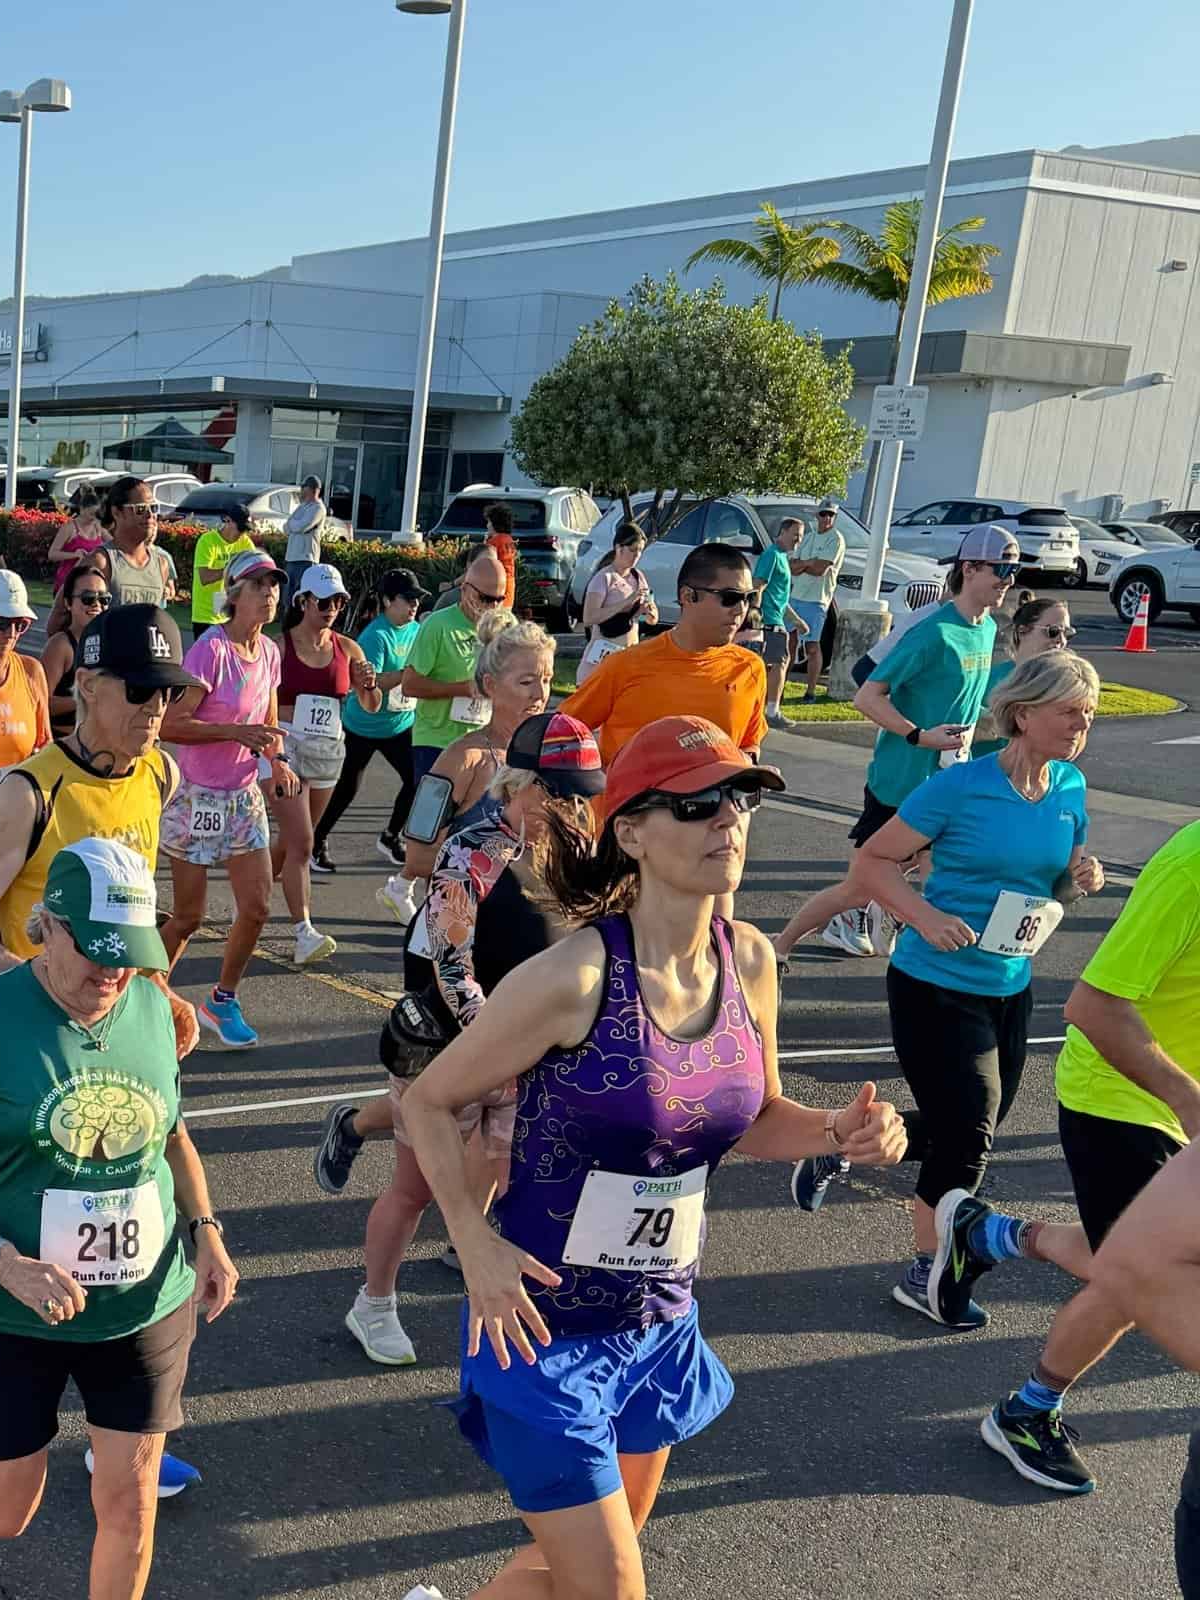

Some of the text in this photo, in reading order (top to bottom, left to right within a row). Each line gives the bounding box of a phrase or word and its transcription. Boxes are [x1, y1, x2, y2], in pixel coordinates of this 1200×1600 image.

[0, 328, 31, 351] Haii
[149, 627, 170, 657] LA
[310, 708, 332, 726] 122
[193, 811, 221, 831] 258
[1015, 915, 1041, 941] 86
[54, 1151, 92, 1175] WINDOR
[647, 1180, 682, 1193] PATH
[94, 1195, 130, 1209] PATH
[626, 1207, 675, 1247] 79
[78, 1219, 140, 1262] 218
[598, 1253, 626, 1265] Run
[628, 1256, 647, 1266] for
[72, 1270, 95, 1281] Run
[99, 1269, 117, 1281] for
